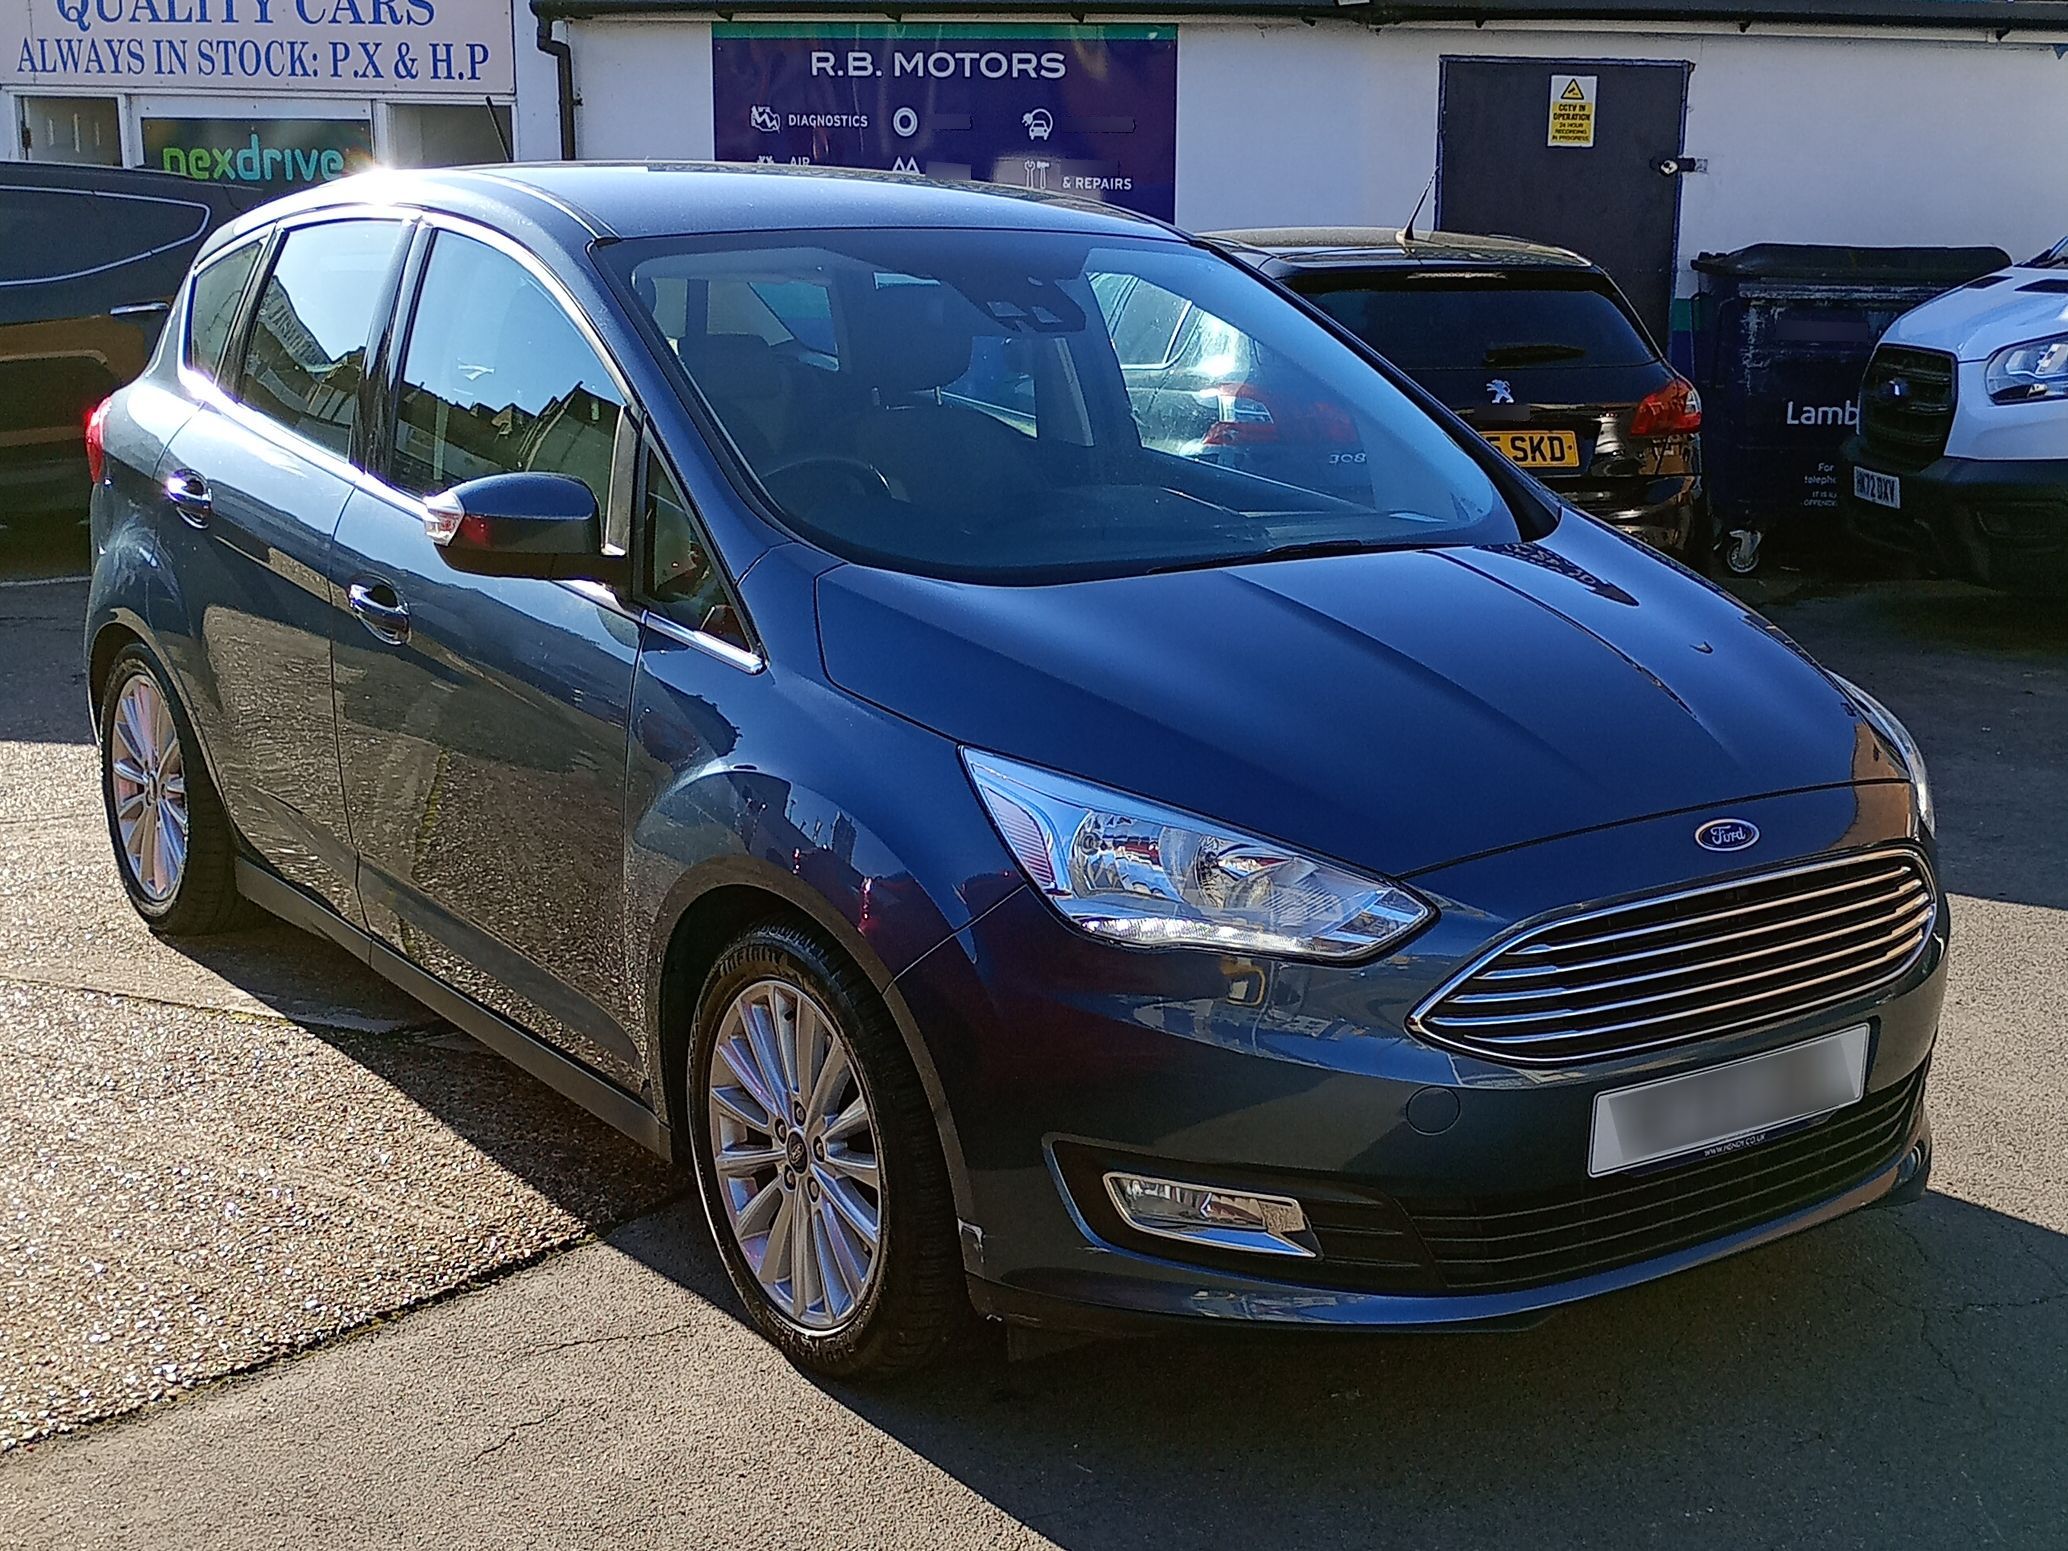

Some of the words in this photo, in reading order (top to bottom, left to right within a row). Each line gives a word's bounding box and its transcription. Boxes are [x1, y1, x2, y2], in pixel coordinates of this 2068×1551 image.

[56, 0, 275, 32] QUALITY
[295, 0, 436, 26] CARS
[16, 37, 146, 75] ALWAYS
[151, 39, 188, 75] IN
[198, 38, 319, 78] STOCK:
[328, 41, 385, 79] P.X
[394, 42, 419, 80] &
[428, 43, 490, 81] H.P
[811, 51, 883, 77] R.B.
[893, 52, 1067, 79] MOTORS
[1553, 113, 1591, 121] OPERATION
[1558, 104, 1577, 112] CCTV
[1578, 104, 1586, 112] IN
[788, 113, 868, 128] DIAGNOSTICS
[163, 133, 345, 182] nexdrive
[790, 156, 811, 167] AIR
[1062, 176, 1072, 189] &
[1075, 177, 1132, 190] REPAIRS
[1786, 400, 1860, 425] Lamb
[1328, 452, 1367, 465] 308
[1510, 435, 1567, 463] SKD
[1710, 825, 1747, 845] Ford
